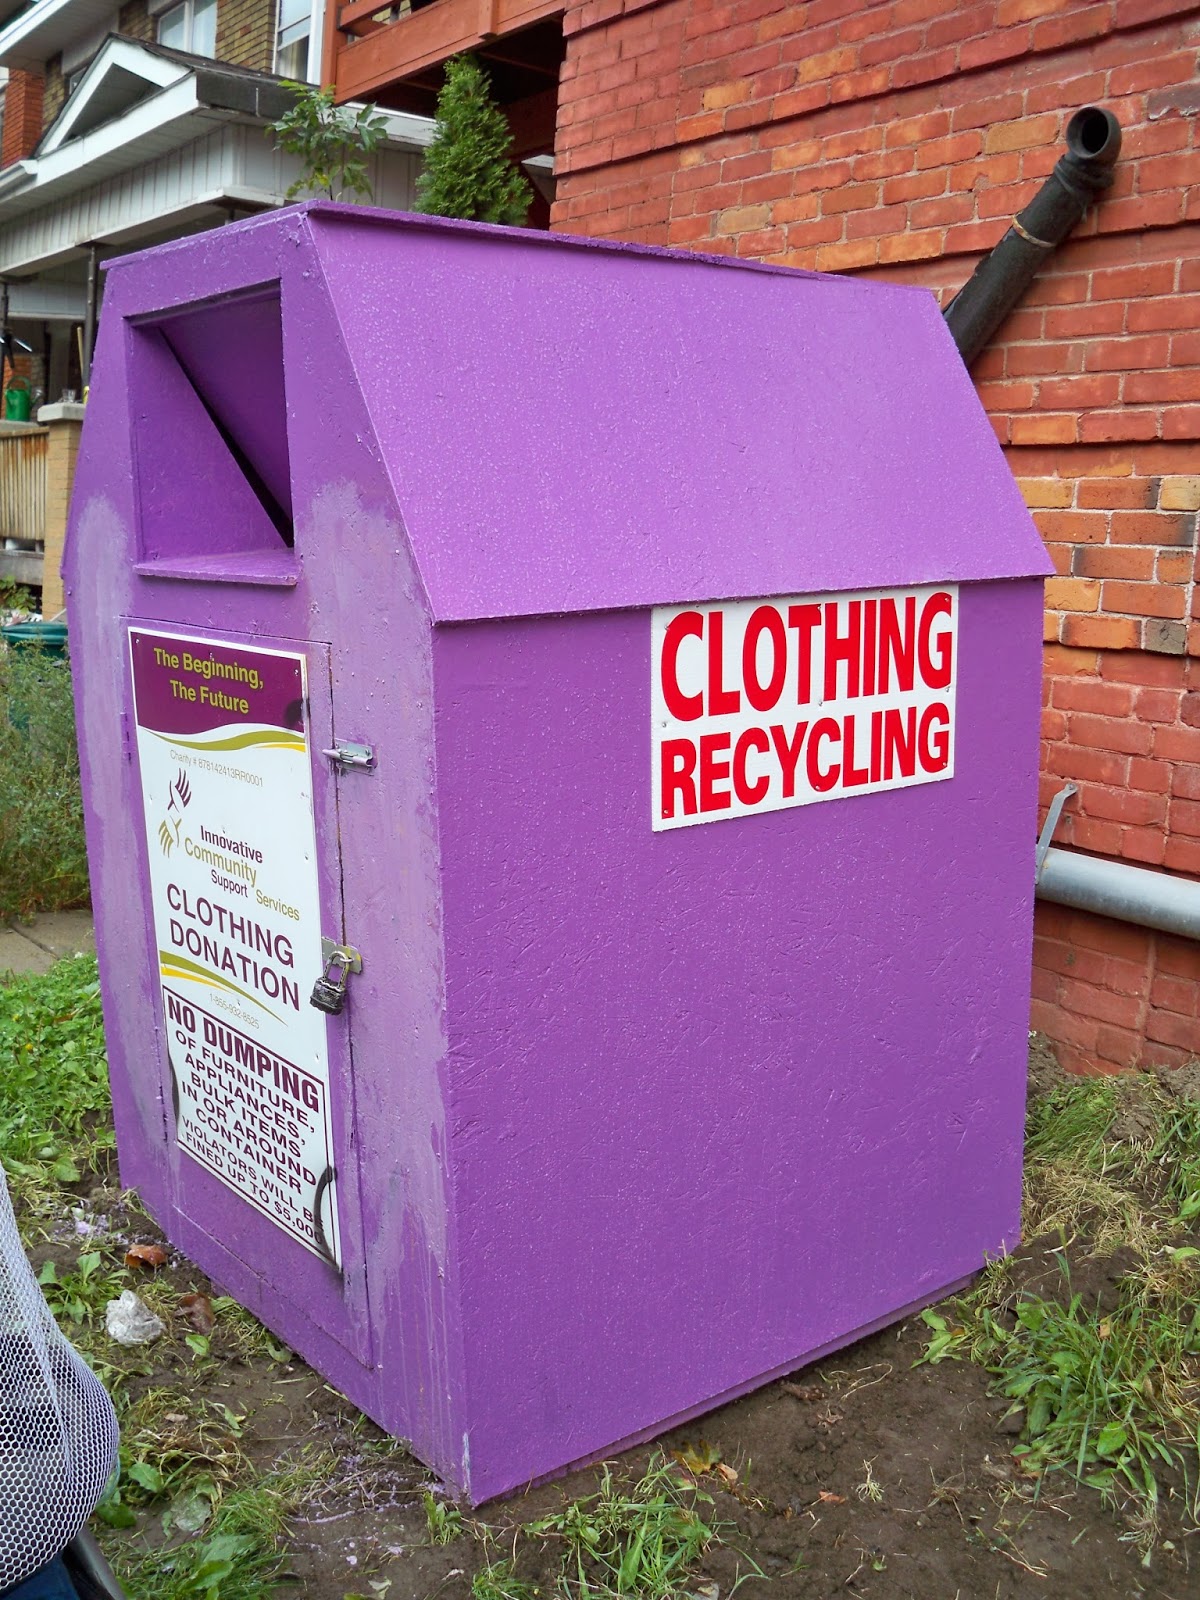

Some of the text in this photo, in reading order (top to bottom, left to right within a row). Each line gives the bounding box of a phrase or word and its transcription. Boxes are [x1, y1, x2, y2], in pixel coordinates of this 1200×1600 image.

[154, 648, 263, 689] The Beginning,
[170, 680, 249, 714] The Future
[661, 592, 952, 722] CLOTHING
[170, 749, 192, 767] Charity
[661, 702, 949, 819] RECYCLING
[184, 837, 257, 887] Community
[200, 825, 263, 863] Innovative
[211, 869, 249, 898] Support
[167, 883, 294, 969] CLOTHING
[256, 889, 300, 921] Services
[170, 918, 300, 1012] DONATION
[168, 994, 319, 1113] NO DUMPING
[175, 1030, 314, 1133] OF FURNITURE,
[182, 1081, 317, 1186] IN OR AROUND
[185, 1053, 305, 1145] APPLIANCES,
[191, 1071, 301, 1158] BULK ITEMS
[182, 1115, 257, 1181] VIOLATORS
[261, 1175, 298, 1213] WILL
[186, 1132, 223, 1168] FINED
[227, 1163, 246, 1183] UP
[250, 1180, 269, 1204] TO
[195, 1108, 302, 1195] CONTAINER
